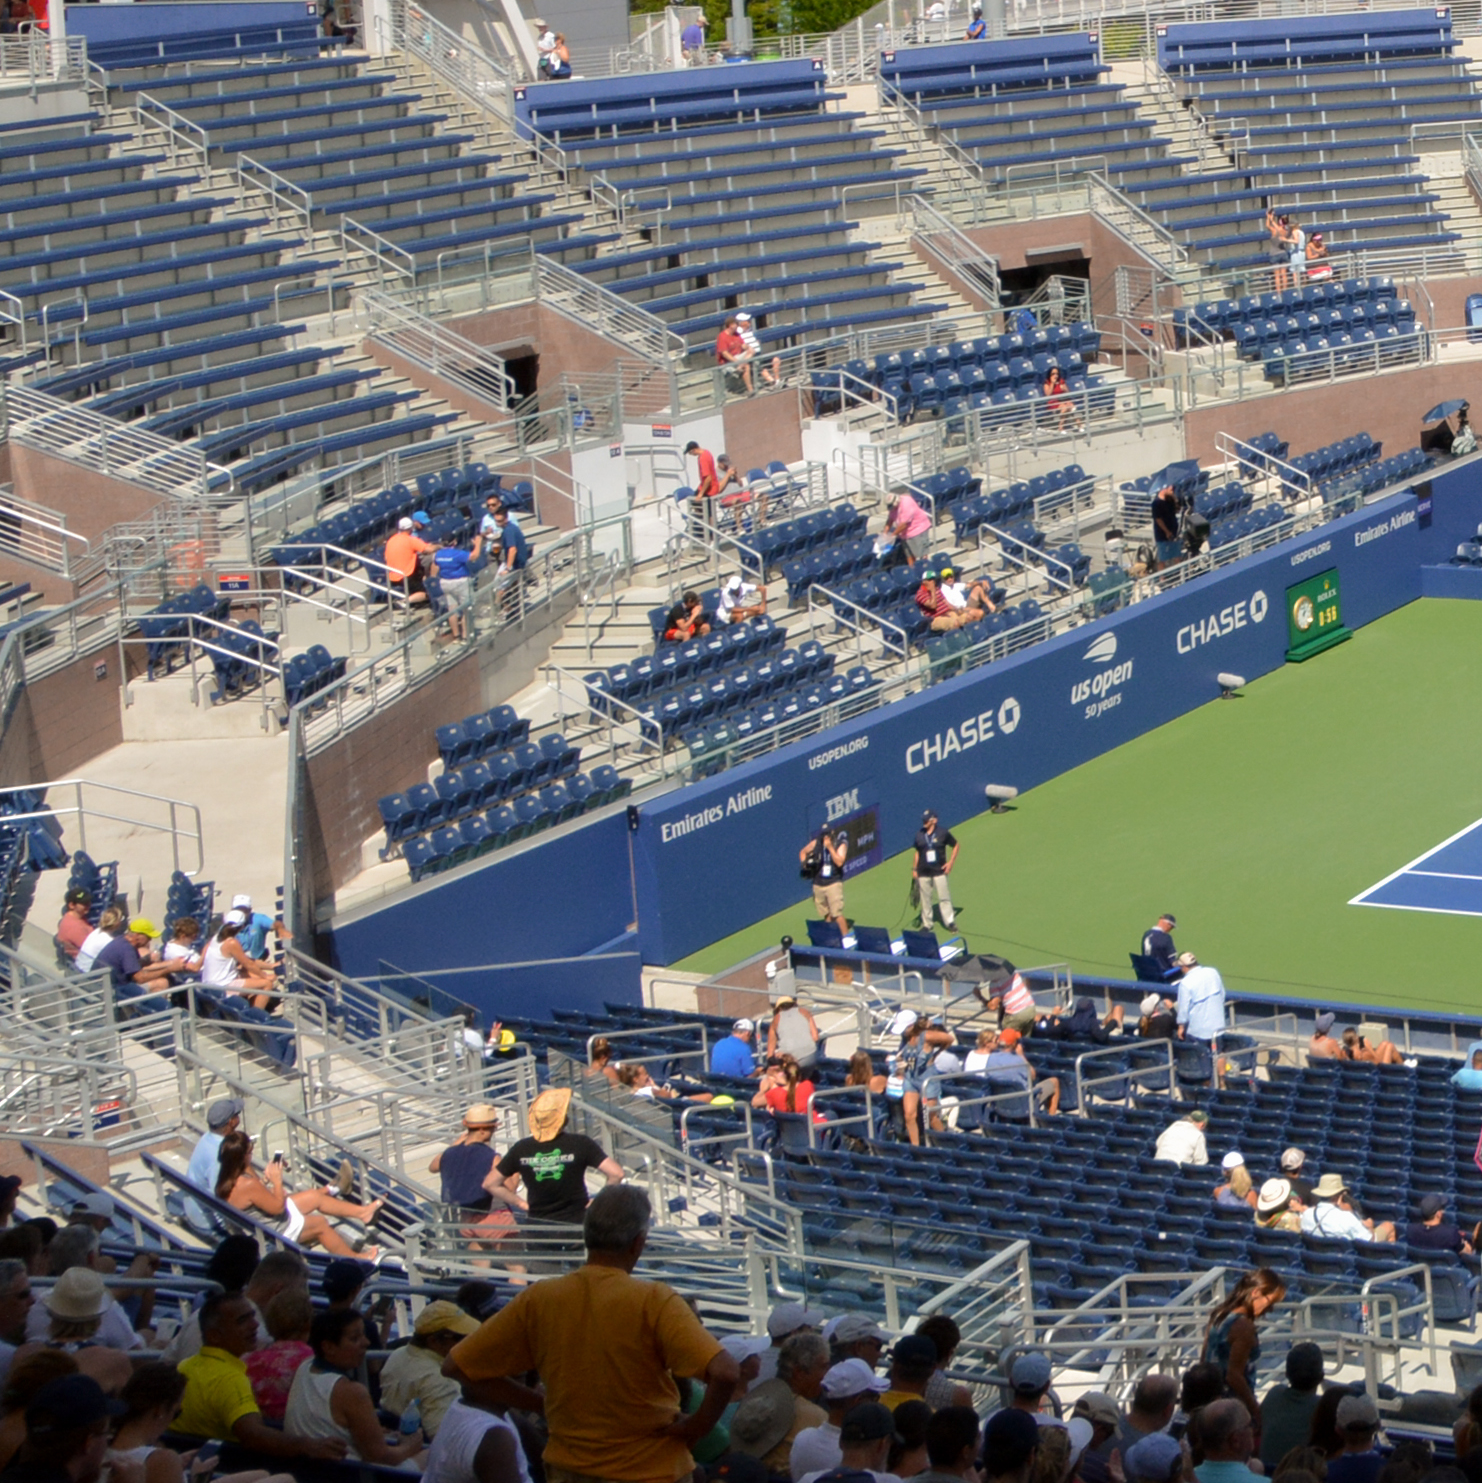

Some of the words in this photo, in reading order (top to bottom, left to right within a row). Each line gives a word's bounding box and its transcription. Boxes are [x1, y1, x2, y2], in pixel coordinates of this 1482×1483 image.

[813, 61, 821, 70] A
[517, 91, 524, 99] A
[1354, 522, 1389, 547] Emirates
[1389, 510, 1415, 532] Airline
[1290, 540, 1332, 566] USOPEN.ORG
[1317, 588, 1336, 603] ROLEX
[1176, 601, 1247, 654] CHASE
[1070, 672, 1091, 705] us
[1091, 659, 1133, 698] open
[1084, 703, 1097, 720] 50
[1096, 693, 1122, 717] years
[808, 735, 869, 771] USOPEN.ORG
[905, 709, 995, 775] CHASE
[660, 804, 724, 844] Emirates
[726, 784, 773, 817] Airline
[825, 788, 862, 823] IBM
[857, 832, 874, 848] MPH
